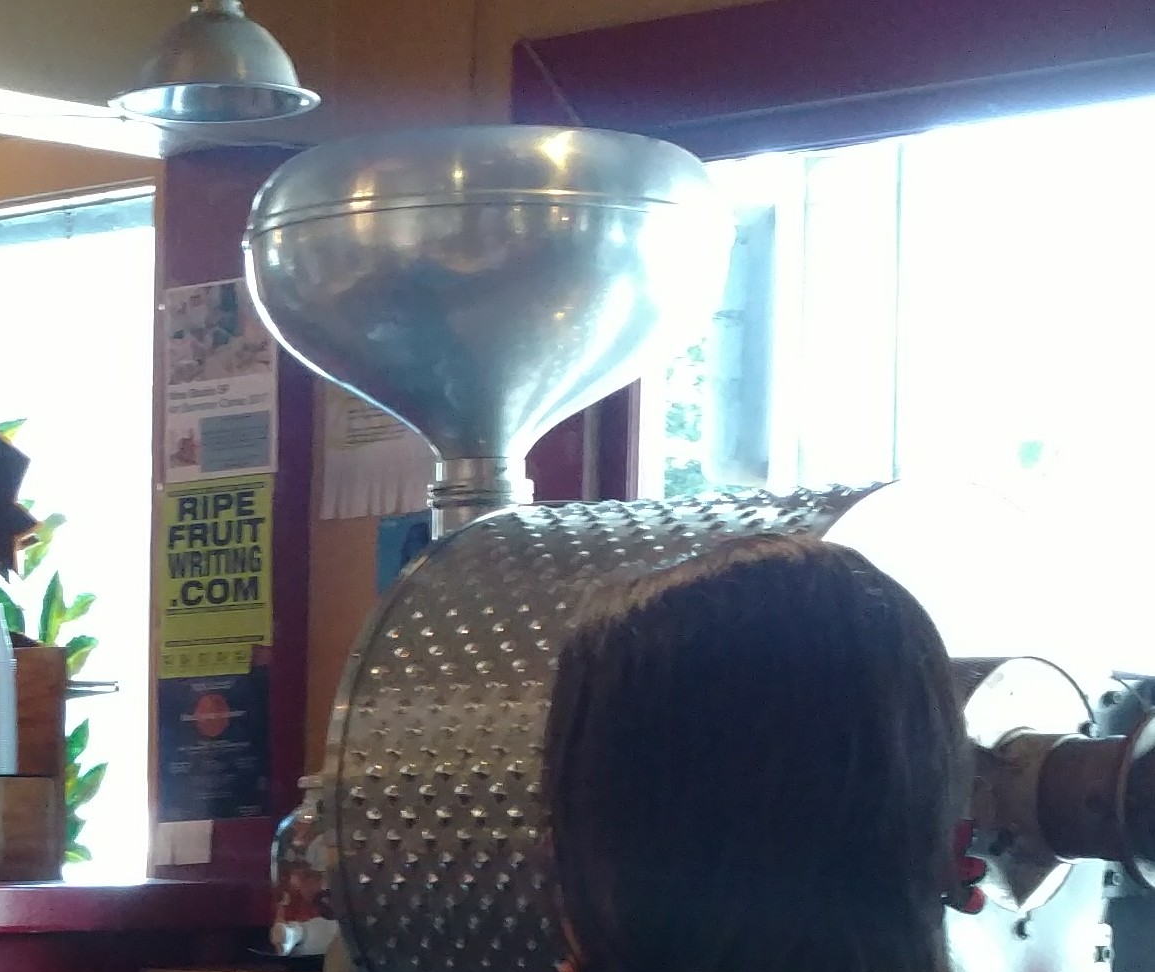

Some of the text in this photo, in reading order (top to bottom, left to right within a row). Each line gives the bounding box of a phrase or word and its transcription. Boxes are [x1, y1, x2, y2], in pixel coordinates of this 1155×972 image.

[178, 491, 256, 521] RIPE
[168, 517, 265, 549] FRUIT
[168, 545, 262, 579] WRITING
[170, 576, 259, 607] .COM
